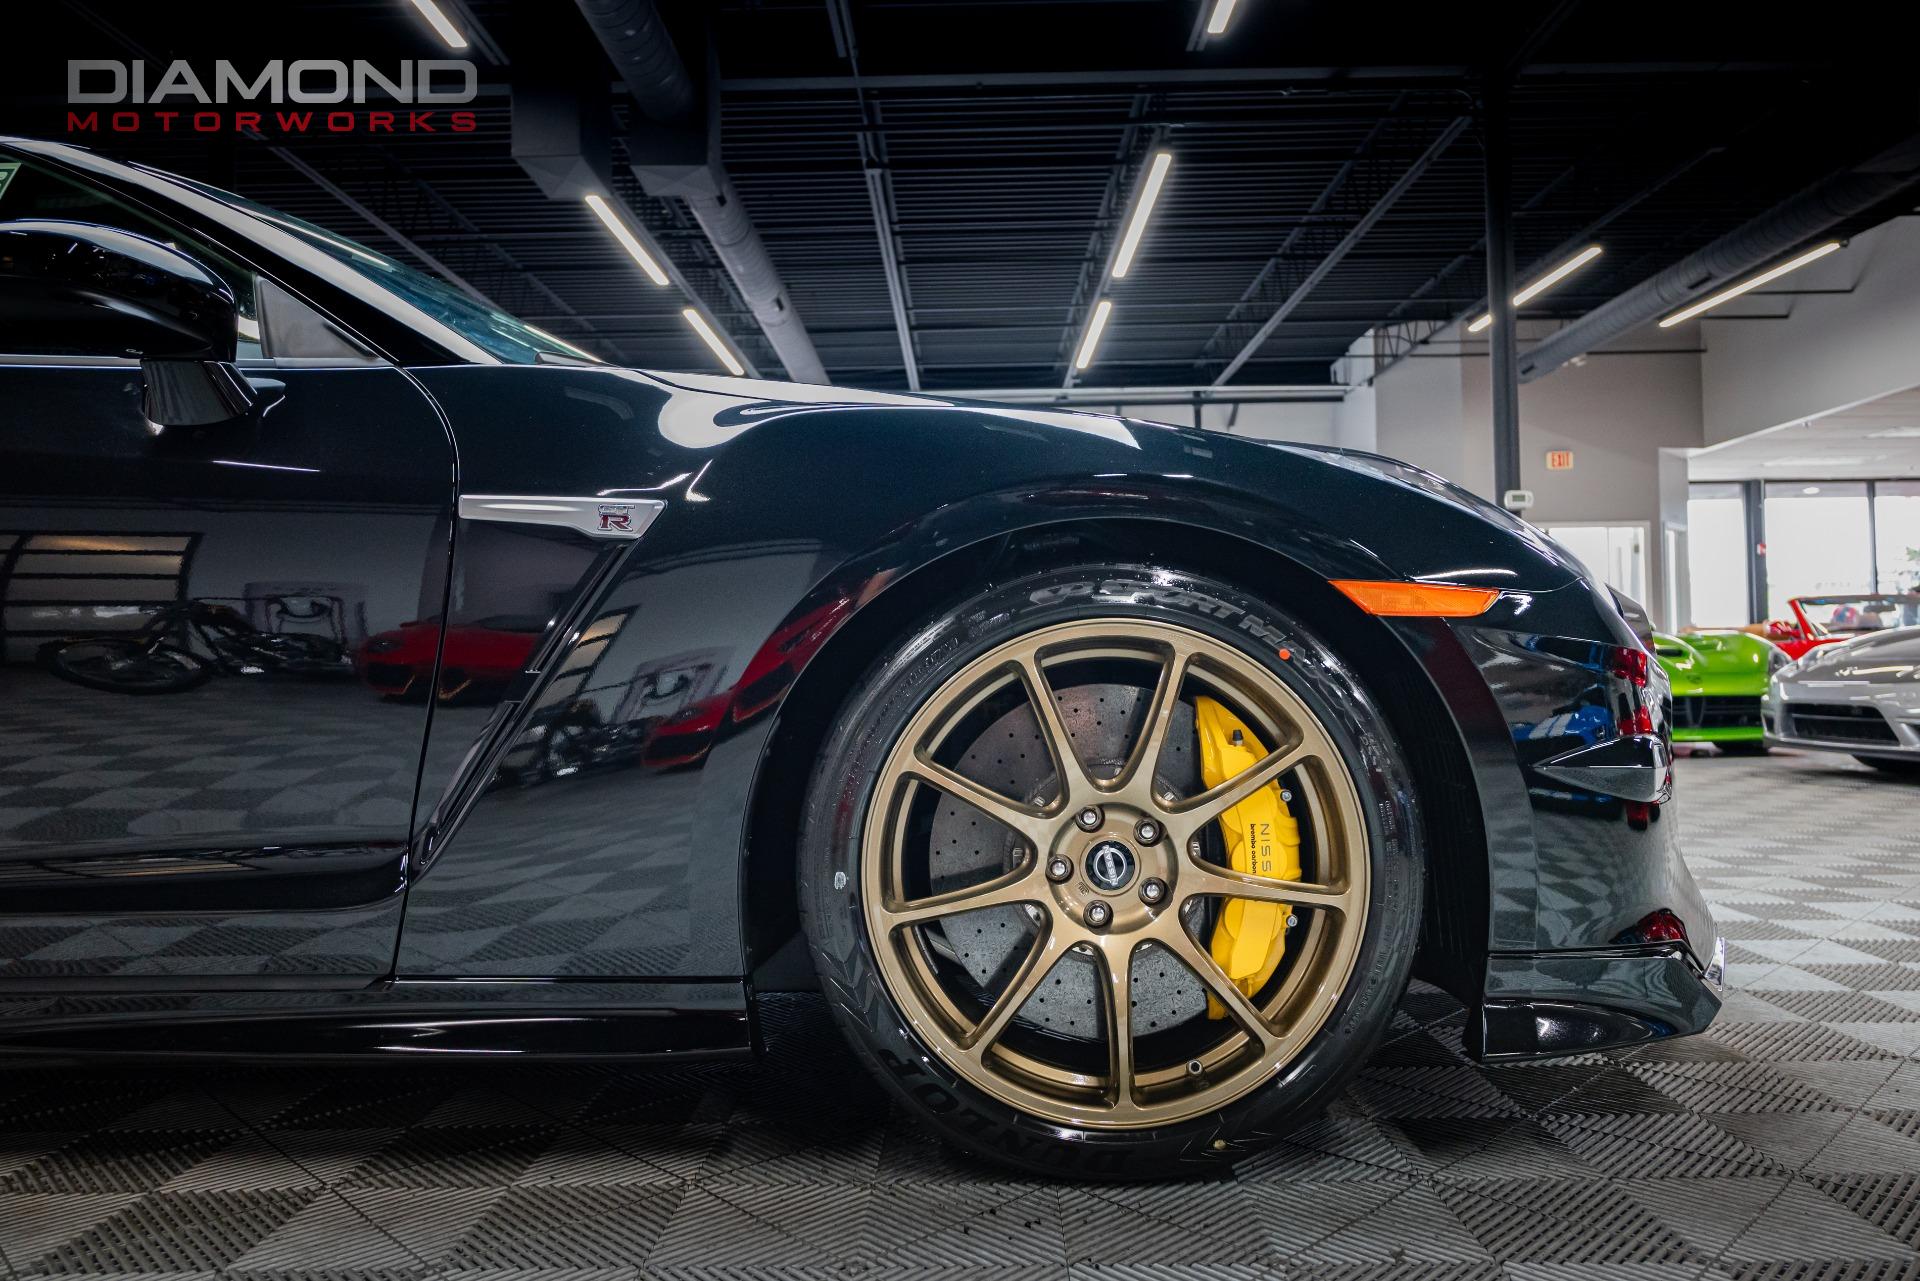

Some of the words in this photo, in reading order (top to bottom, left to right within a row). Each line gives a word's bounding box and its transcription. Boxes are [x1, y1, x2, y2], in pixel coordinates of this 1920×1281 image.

[1551, 451, 1570, 468] EXIT
[1102, 844, 1118, 887] NISSAN
[1260, 823, 1271, 872] NISS
